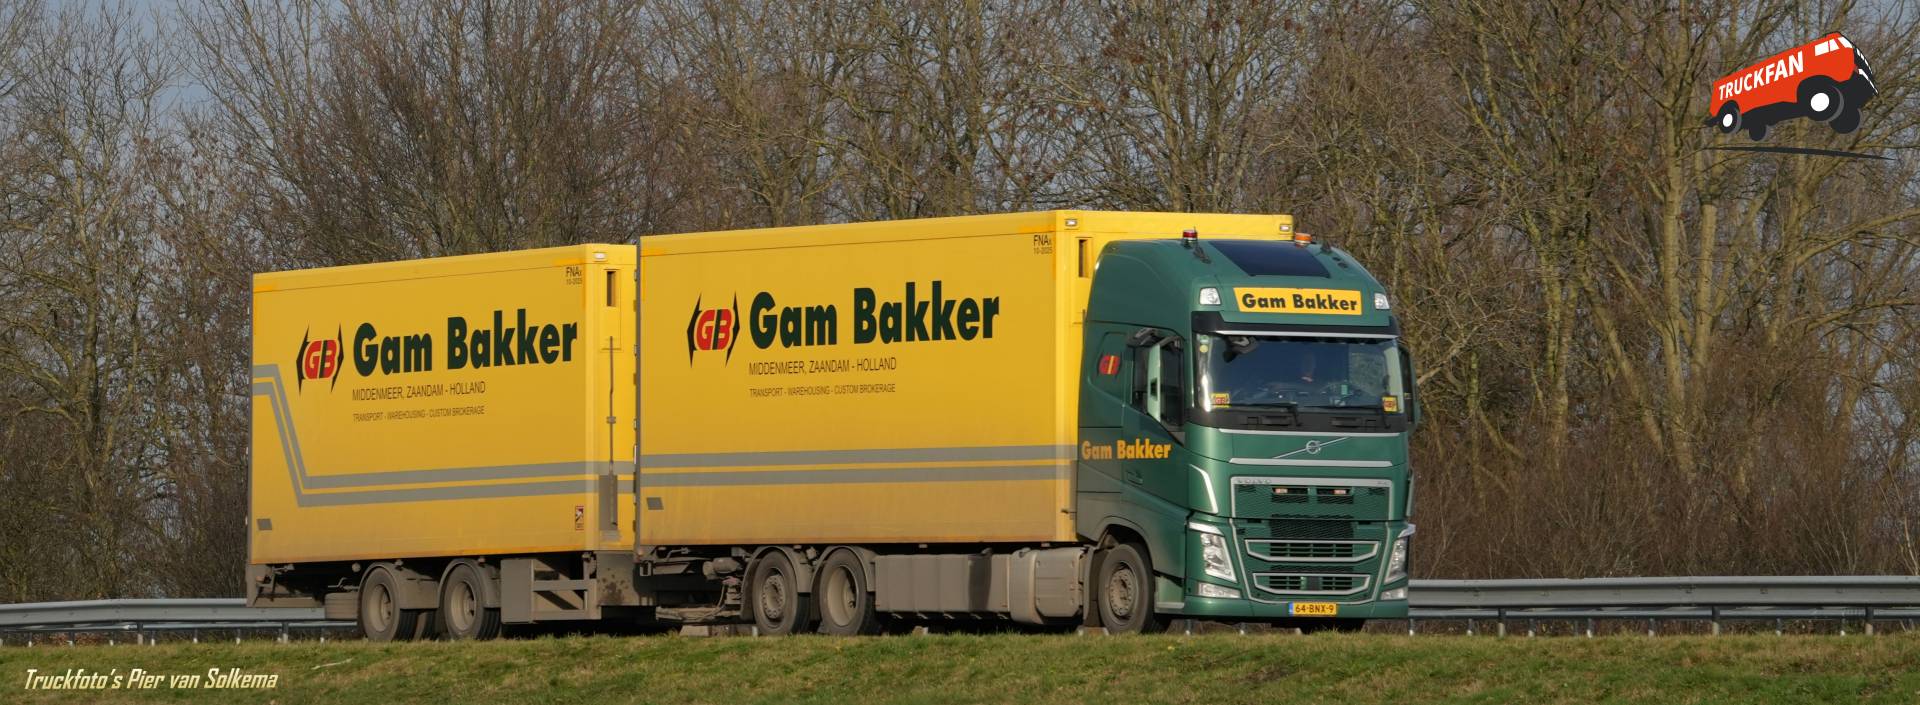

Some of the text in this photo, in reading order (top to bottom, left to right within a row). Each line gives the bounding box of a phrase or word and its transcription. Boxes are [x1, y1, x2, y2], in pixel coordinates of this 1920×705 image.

[1242, 293, 1358, 311] Gam Bakker
[750, 280, 1000, 350] Gam Bakker
[696, 308, 733, 351] GB
[353, 308, 578, 378] Gam Bakker
[304, 339, 337, 380] GB
[749, 360, 807, 376] MIDDENMEER,
[808, 359, 850, 374] ZAANDAM
[856, 357, 897, 372] HOLLAND
[406, 384, 444, 399] ZAANDAM
[450, 381, 486, 396] HOLLAND
[750, 387, 783, 398] TRANSPORT
[788, 385, 830, 397] WAREHOUSING
[834, 384, 858, 395] CUSTOM
[859, 383, 896, 394] BROKERAGE
[353, 411, 384, 422] TRANSPORT
[429, 407, 452, 418] CUSTOM
[452, 405, 485, 417] BROKERAGE
[1081, 438, 1171, 460] Gam Bakker
[1295, 604, 1335, 614] 64-BNX-9
